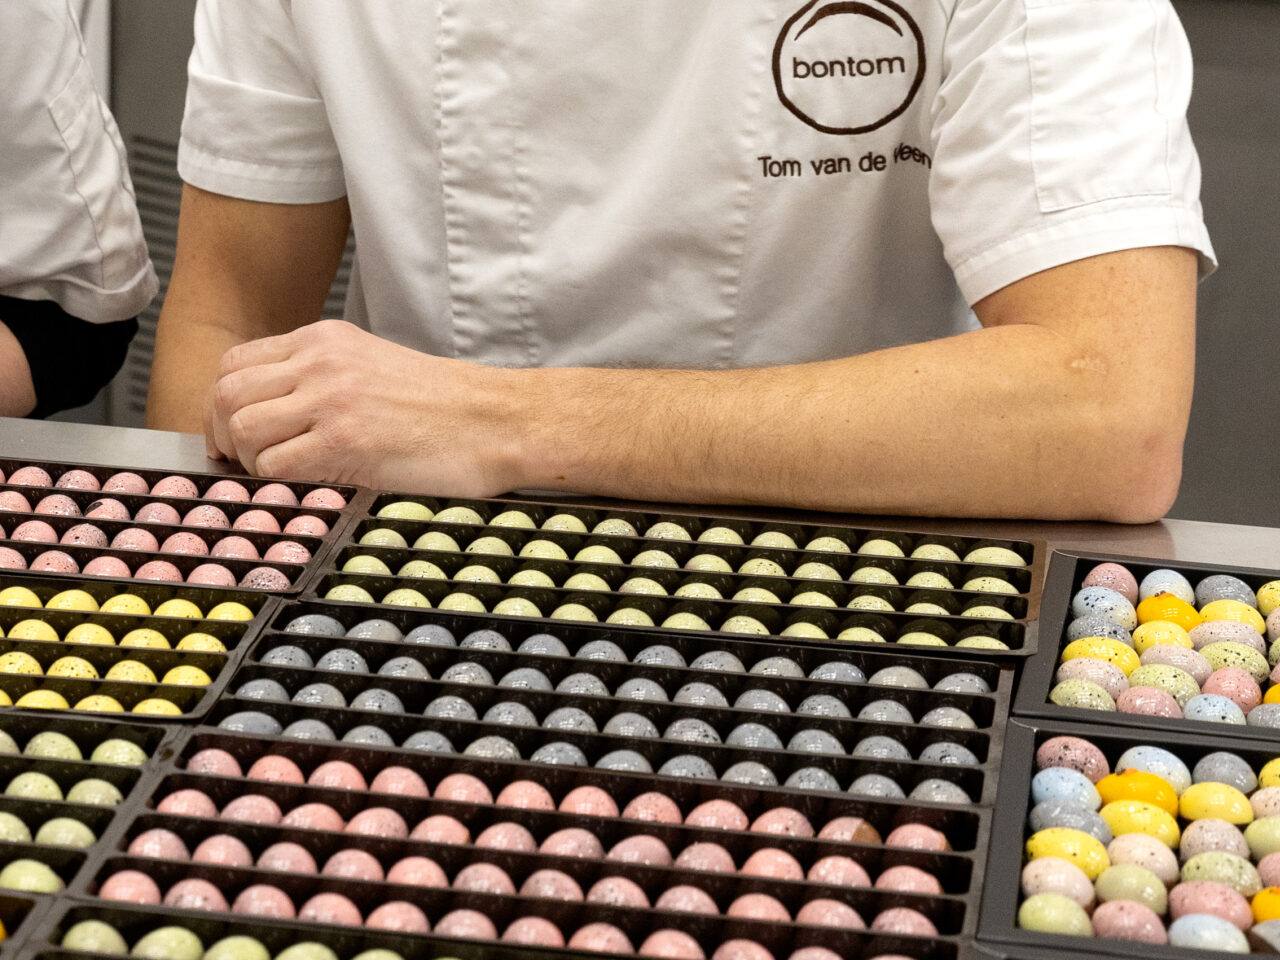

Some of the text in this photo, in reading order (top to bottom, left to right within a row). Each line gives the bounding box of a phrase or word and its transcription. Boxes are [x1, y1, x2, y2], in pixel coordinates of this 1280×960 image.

[792, 56, 906, 79] bontom
[757, 155, 802, 178] Tom
[810, 156, 851, 176] van
[859, 151, 887, 172] de
